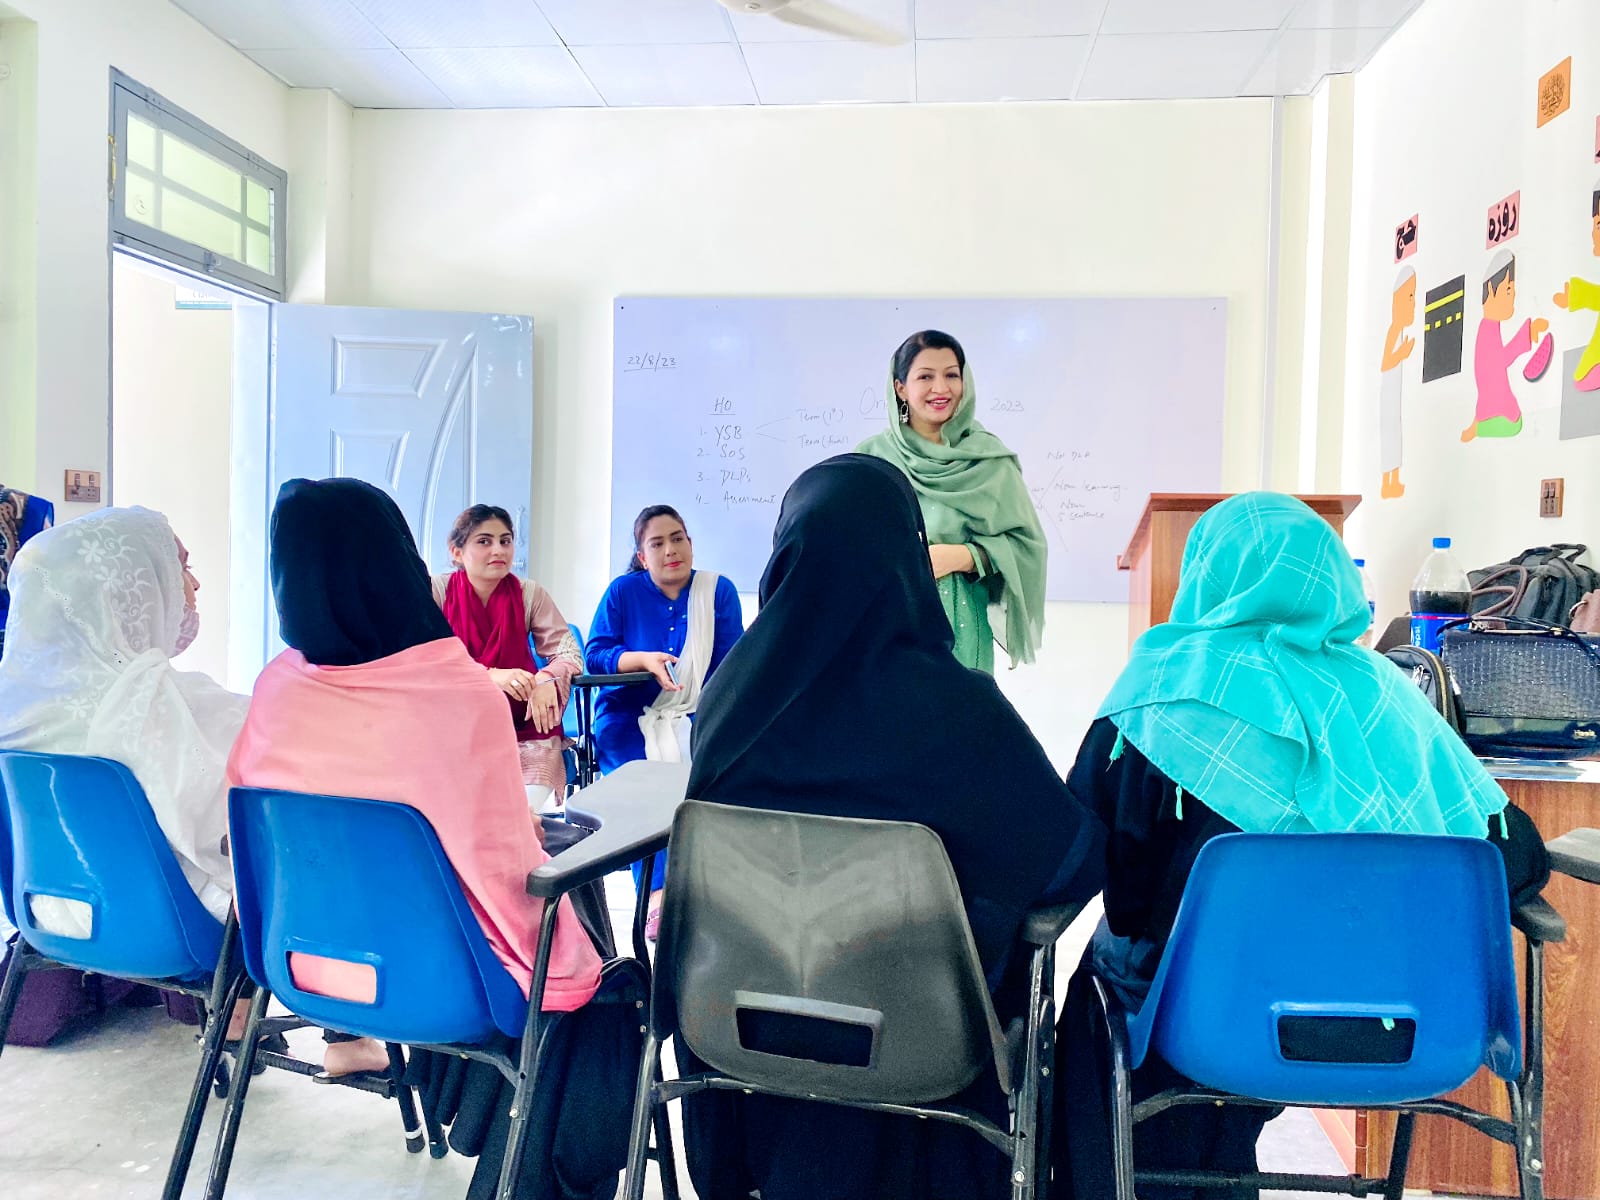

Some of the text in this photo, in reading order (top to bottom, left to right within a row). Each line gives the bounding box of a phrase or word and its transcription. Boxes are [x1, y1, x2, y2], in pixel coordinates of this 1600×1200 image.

[1488, 201, 1517, 242] روزه
[1396, 219, 1417, 260] حج
[860, 387, 1025, 415] Ori 2023
[714, 424, 743, 447] YSB
[1414, 626, 1422, 647] epsi
